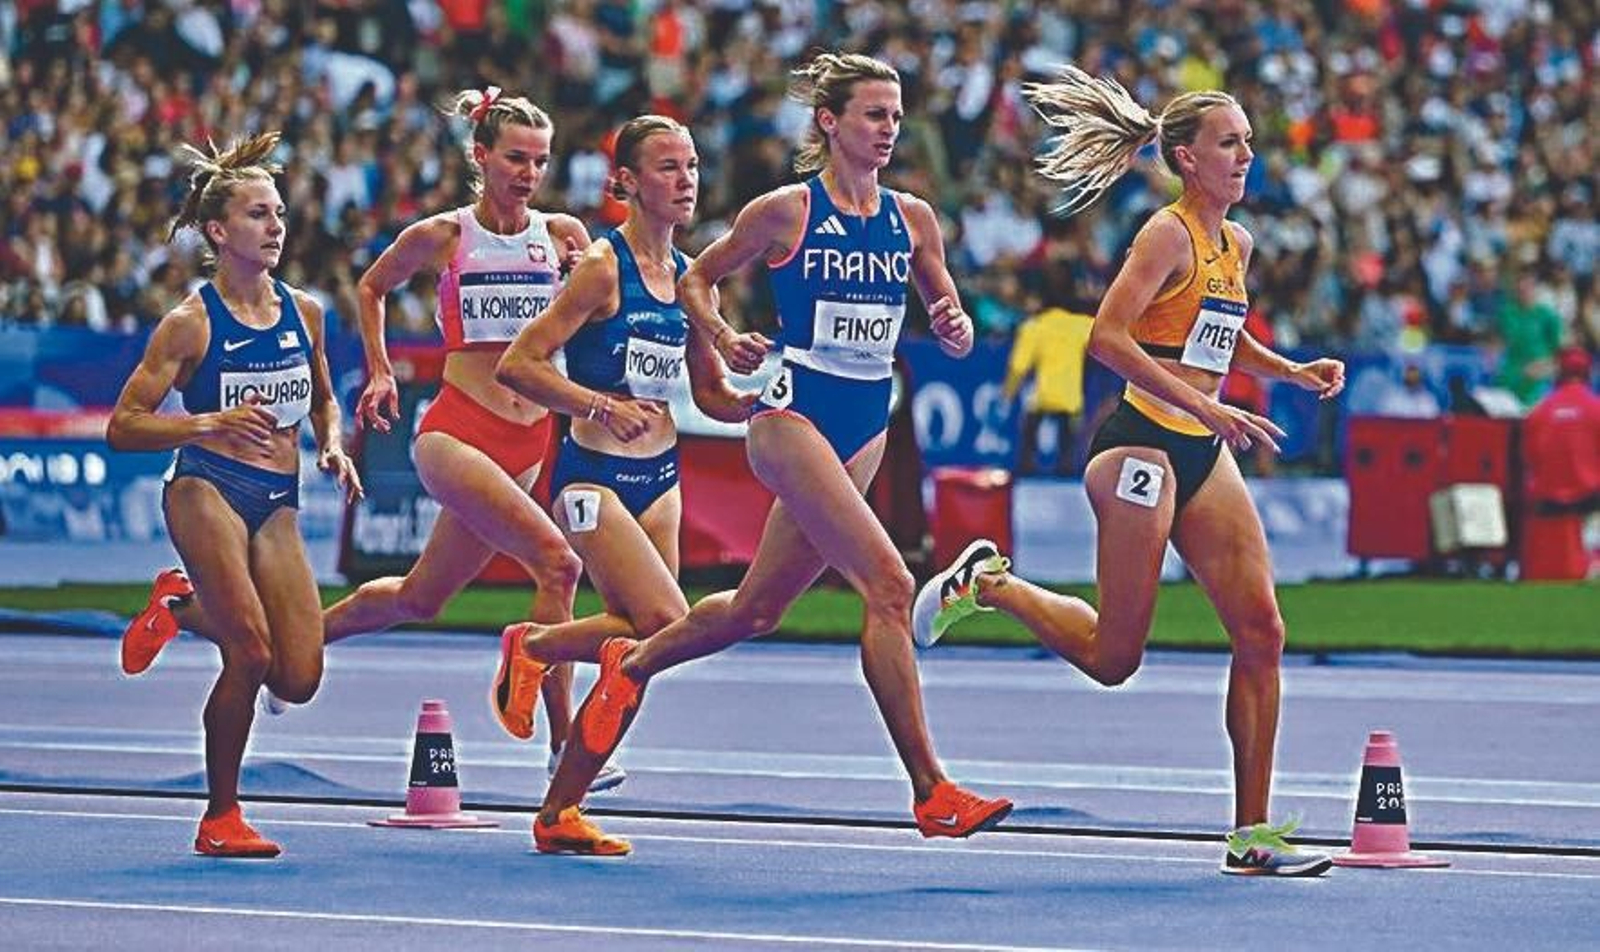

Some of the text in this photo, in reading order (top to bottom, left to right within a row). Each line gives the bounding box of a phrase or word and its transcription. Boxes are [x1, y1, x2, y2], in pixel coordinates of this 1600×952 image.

[804, 249, 911, 282] FRANC
[462, 297, 478, 319] AL
[833, 316, 893, 342] FINOT
[225, 378, 310, 408] HOWARD
[1130, 469, 1151, 497] 2
[574, 498, 586, 524] 1
[431, 761, 457, 774] 20
[1376, 796, 1405, 810] 20
